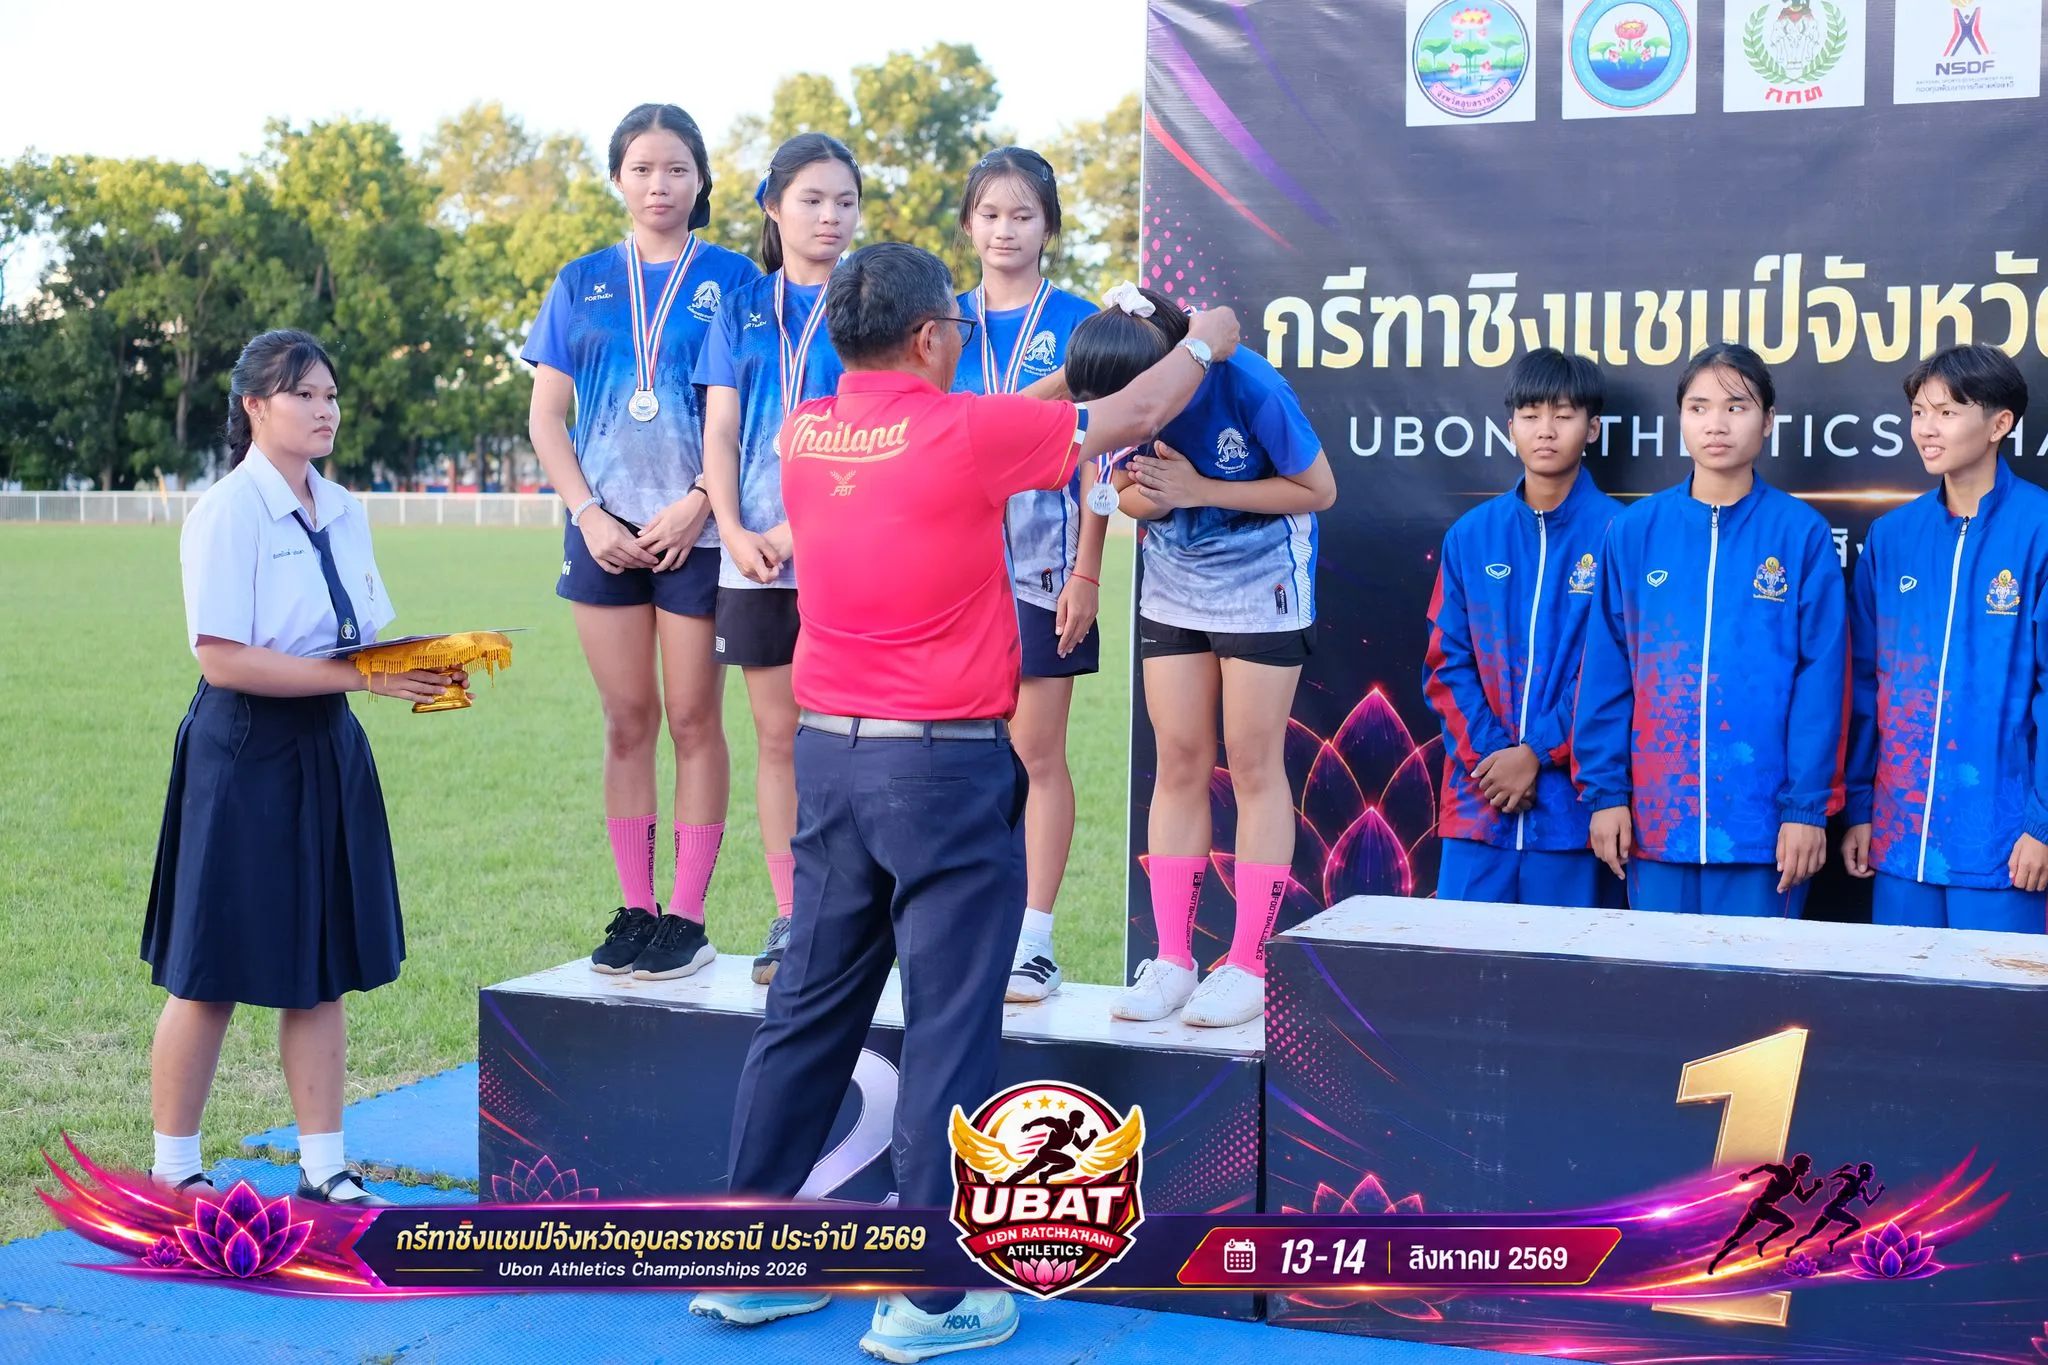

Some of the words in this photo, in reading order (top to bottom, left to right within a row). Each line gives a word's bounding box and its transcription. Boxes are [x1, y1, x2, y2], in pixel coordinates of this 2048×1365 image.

[1936, 60, 1995, 76] NSDF
[1765, 86, 1823, 104] กกท
[1263, 251, 2048, 369] กรีฑาชิงแชมป์จังหวั
[788, 408, 910, 463] Thailand
[1350, 415, 1517, 457] UBON
[1582, 414, 1904, 457] THTICS
[830, 485, 856, 497] FBT
[1652, 1028, 1808, 1327] 1
[942, 1314, 981, 1329] HOKA
